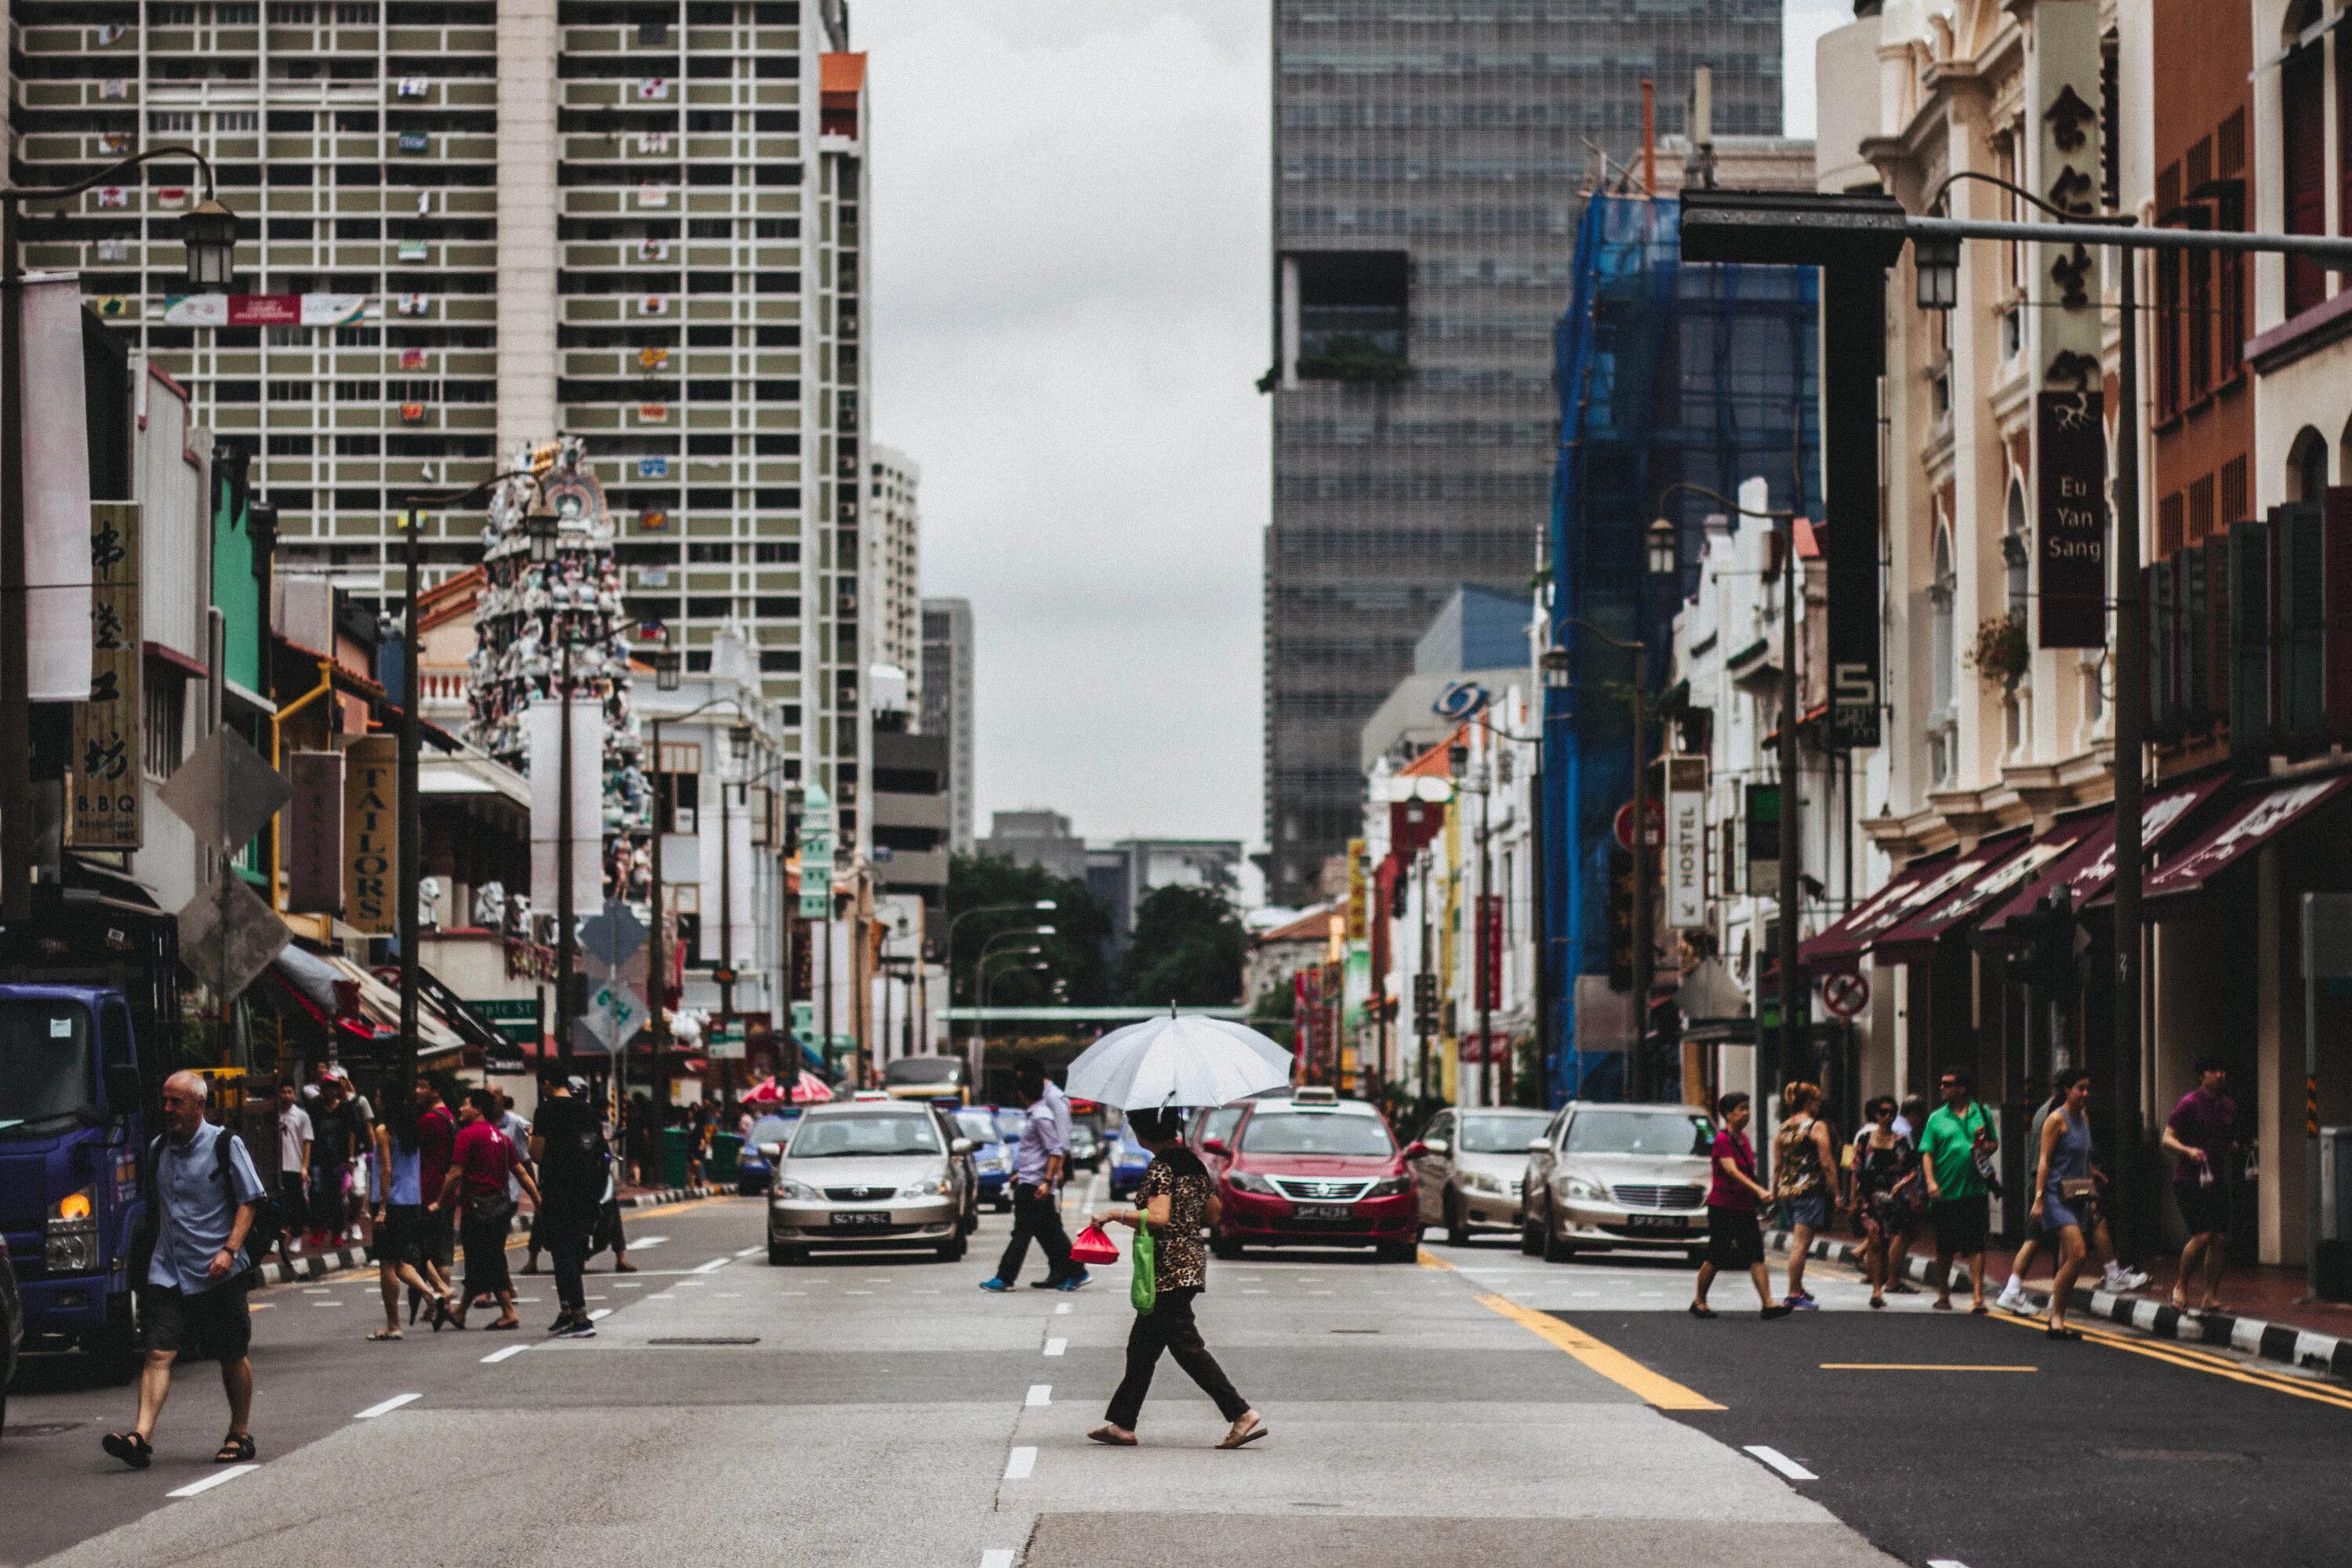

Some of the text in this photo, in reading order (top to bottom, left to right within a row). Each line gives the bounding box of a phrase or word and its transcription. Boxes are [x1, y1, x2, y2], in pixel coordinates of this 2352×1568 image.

[2060, 476, 2086, 497] Eu
[2057, 507, 2092, 528] Yan
[2049, 536, 2100, 563] Sang
[354, 767, 388, 920] TAILORS
[1679, 808, 1694, 887] HOSTEL
[473, 1004, 532, 1017] mple St
